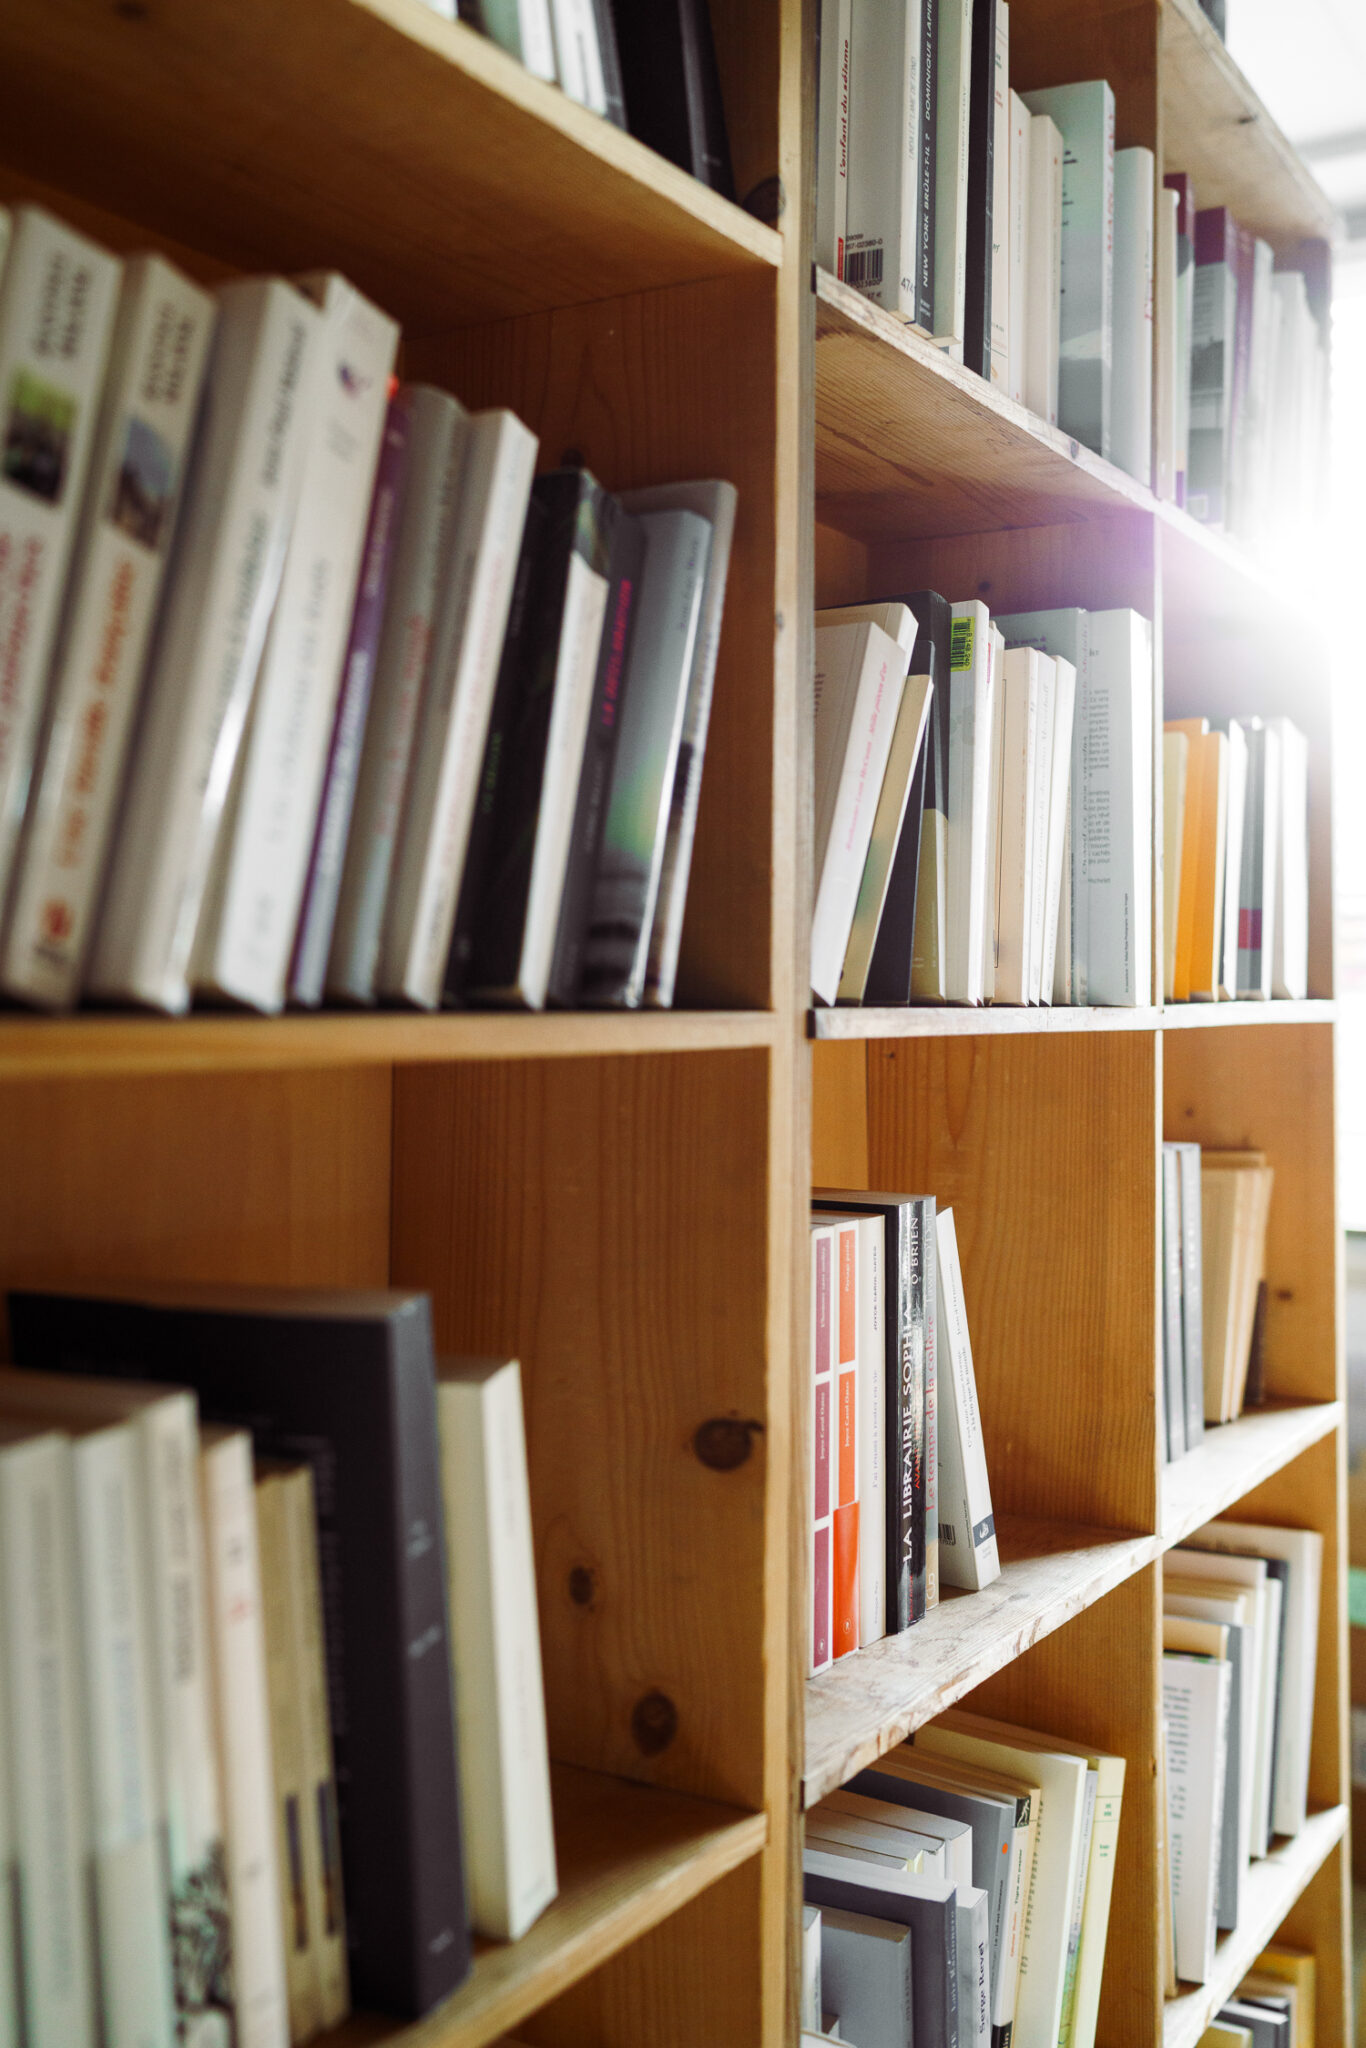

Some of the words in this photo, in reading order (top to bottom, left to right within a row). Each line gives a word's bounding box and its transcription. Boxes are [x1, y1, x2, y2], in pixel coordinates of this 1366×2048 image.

[841, 95, 848, 114] du
[839, 118, 847, 178] L'enfant
[922, 146, 930, 210] BRÛLE-T-IL
[911, 1217, 919, 1285] O'BRIEN
[902, 1303, 913, 1396] SOPHIA
[924, 1316, 934, 1372] colère
[924, 1378, 935, 1393] la
[925, 1398, 934, 1419] de
[902, 1404, 913, 1519] LIBRAIRIE
[926, 1426, 936, 1482] temps
[925, 1486, 935, 1512] Le
[902, 1526, 912, 1563] LA
[978, 1990, 986, 2034] Serge
